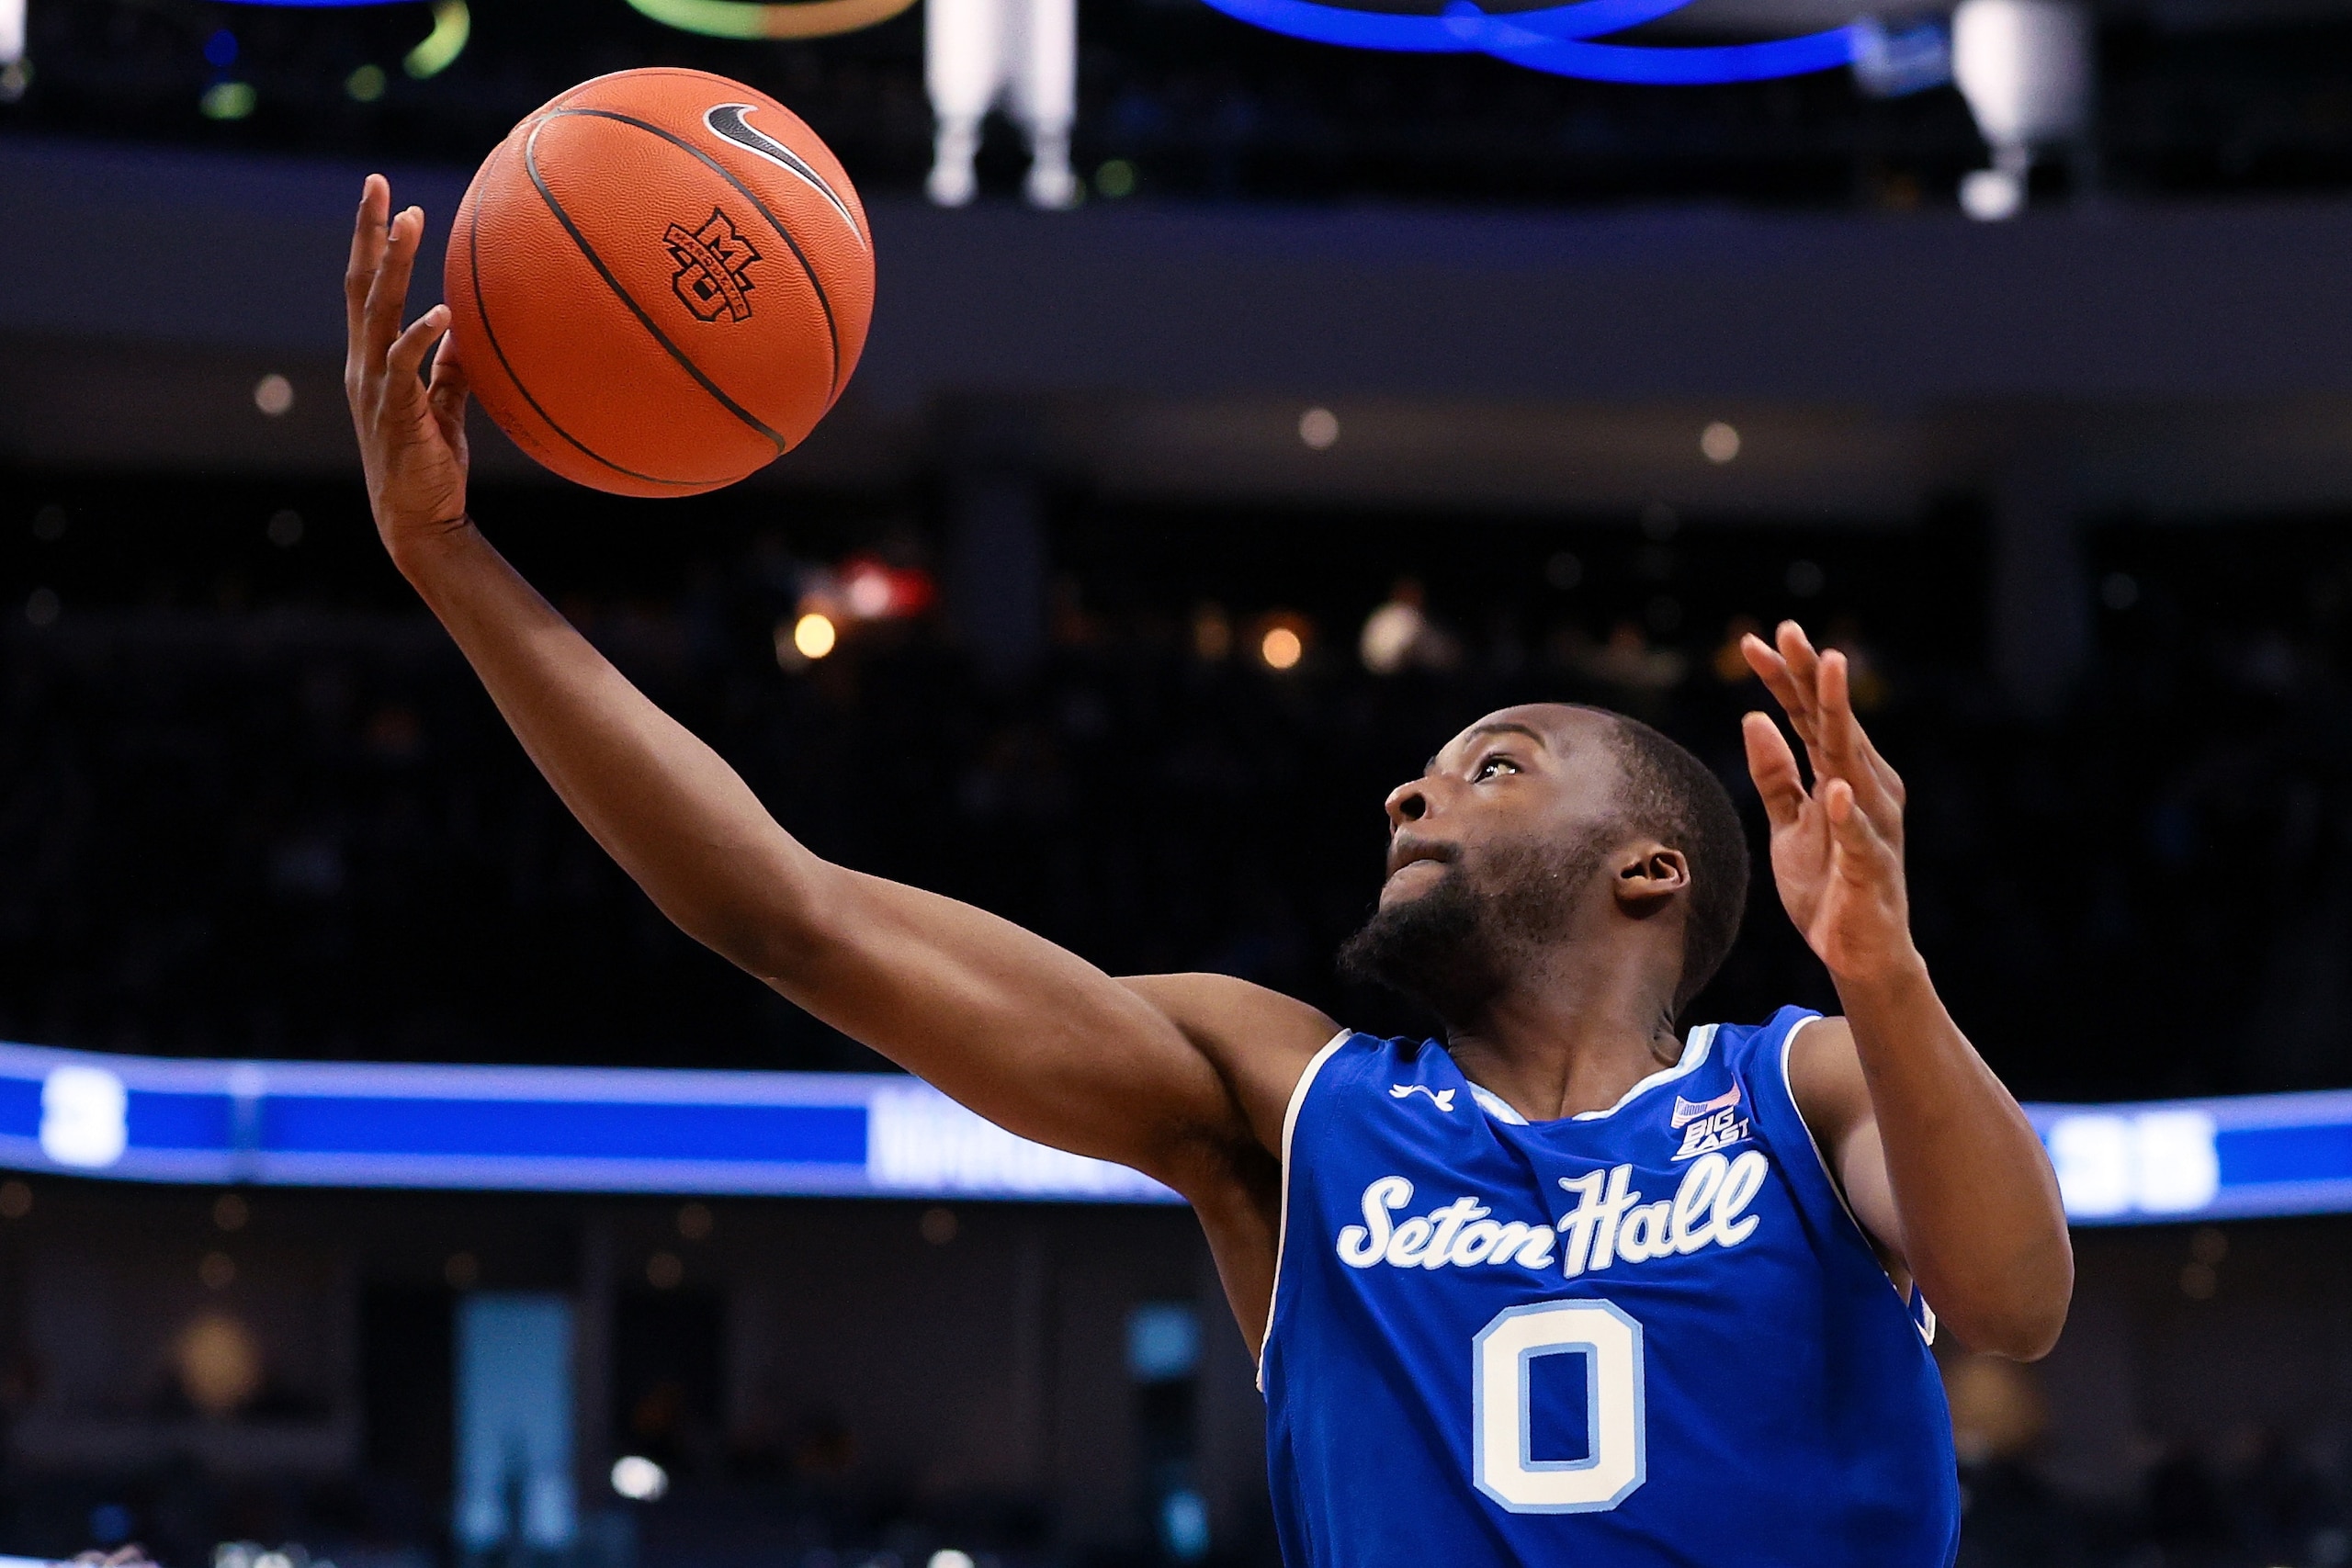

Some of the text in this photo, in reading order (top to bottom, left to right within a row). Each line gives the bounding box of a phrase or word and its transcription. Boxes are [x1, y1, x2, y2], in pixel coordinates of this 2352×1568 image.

[1676, 1117, 1749, 1156] EAST
[1683, 1105, 1735, 1145] BIG
[1336, 1150, 1770, 1279] Seton Hall
[1472, 1298, 1646, 1515] 0
